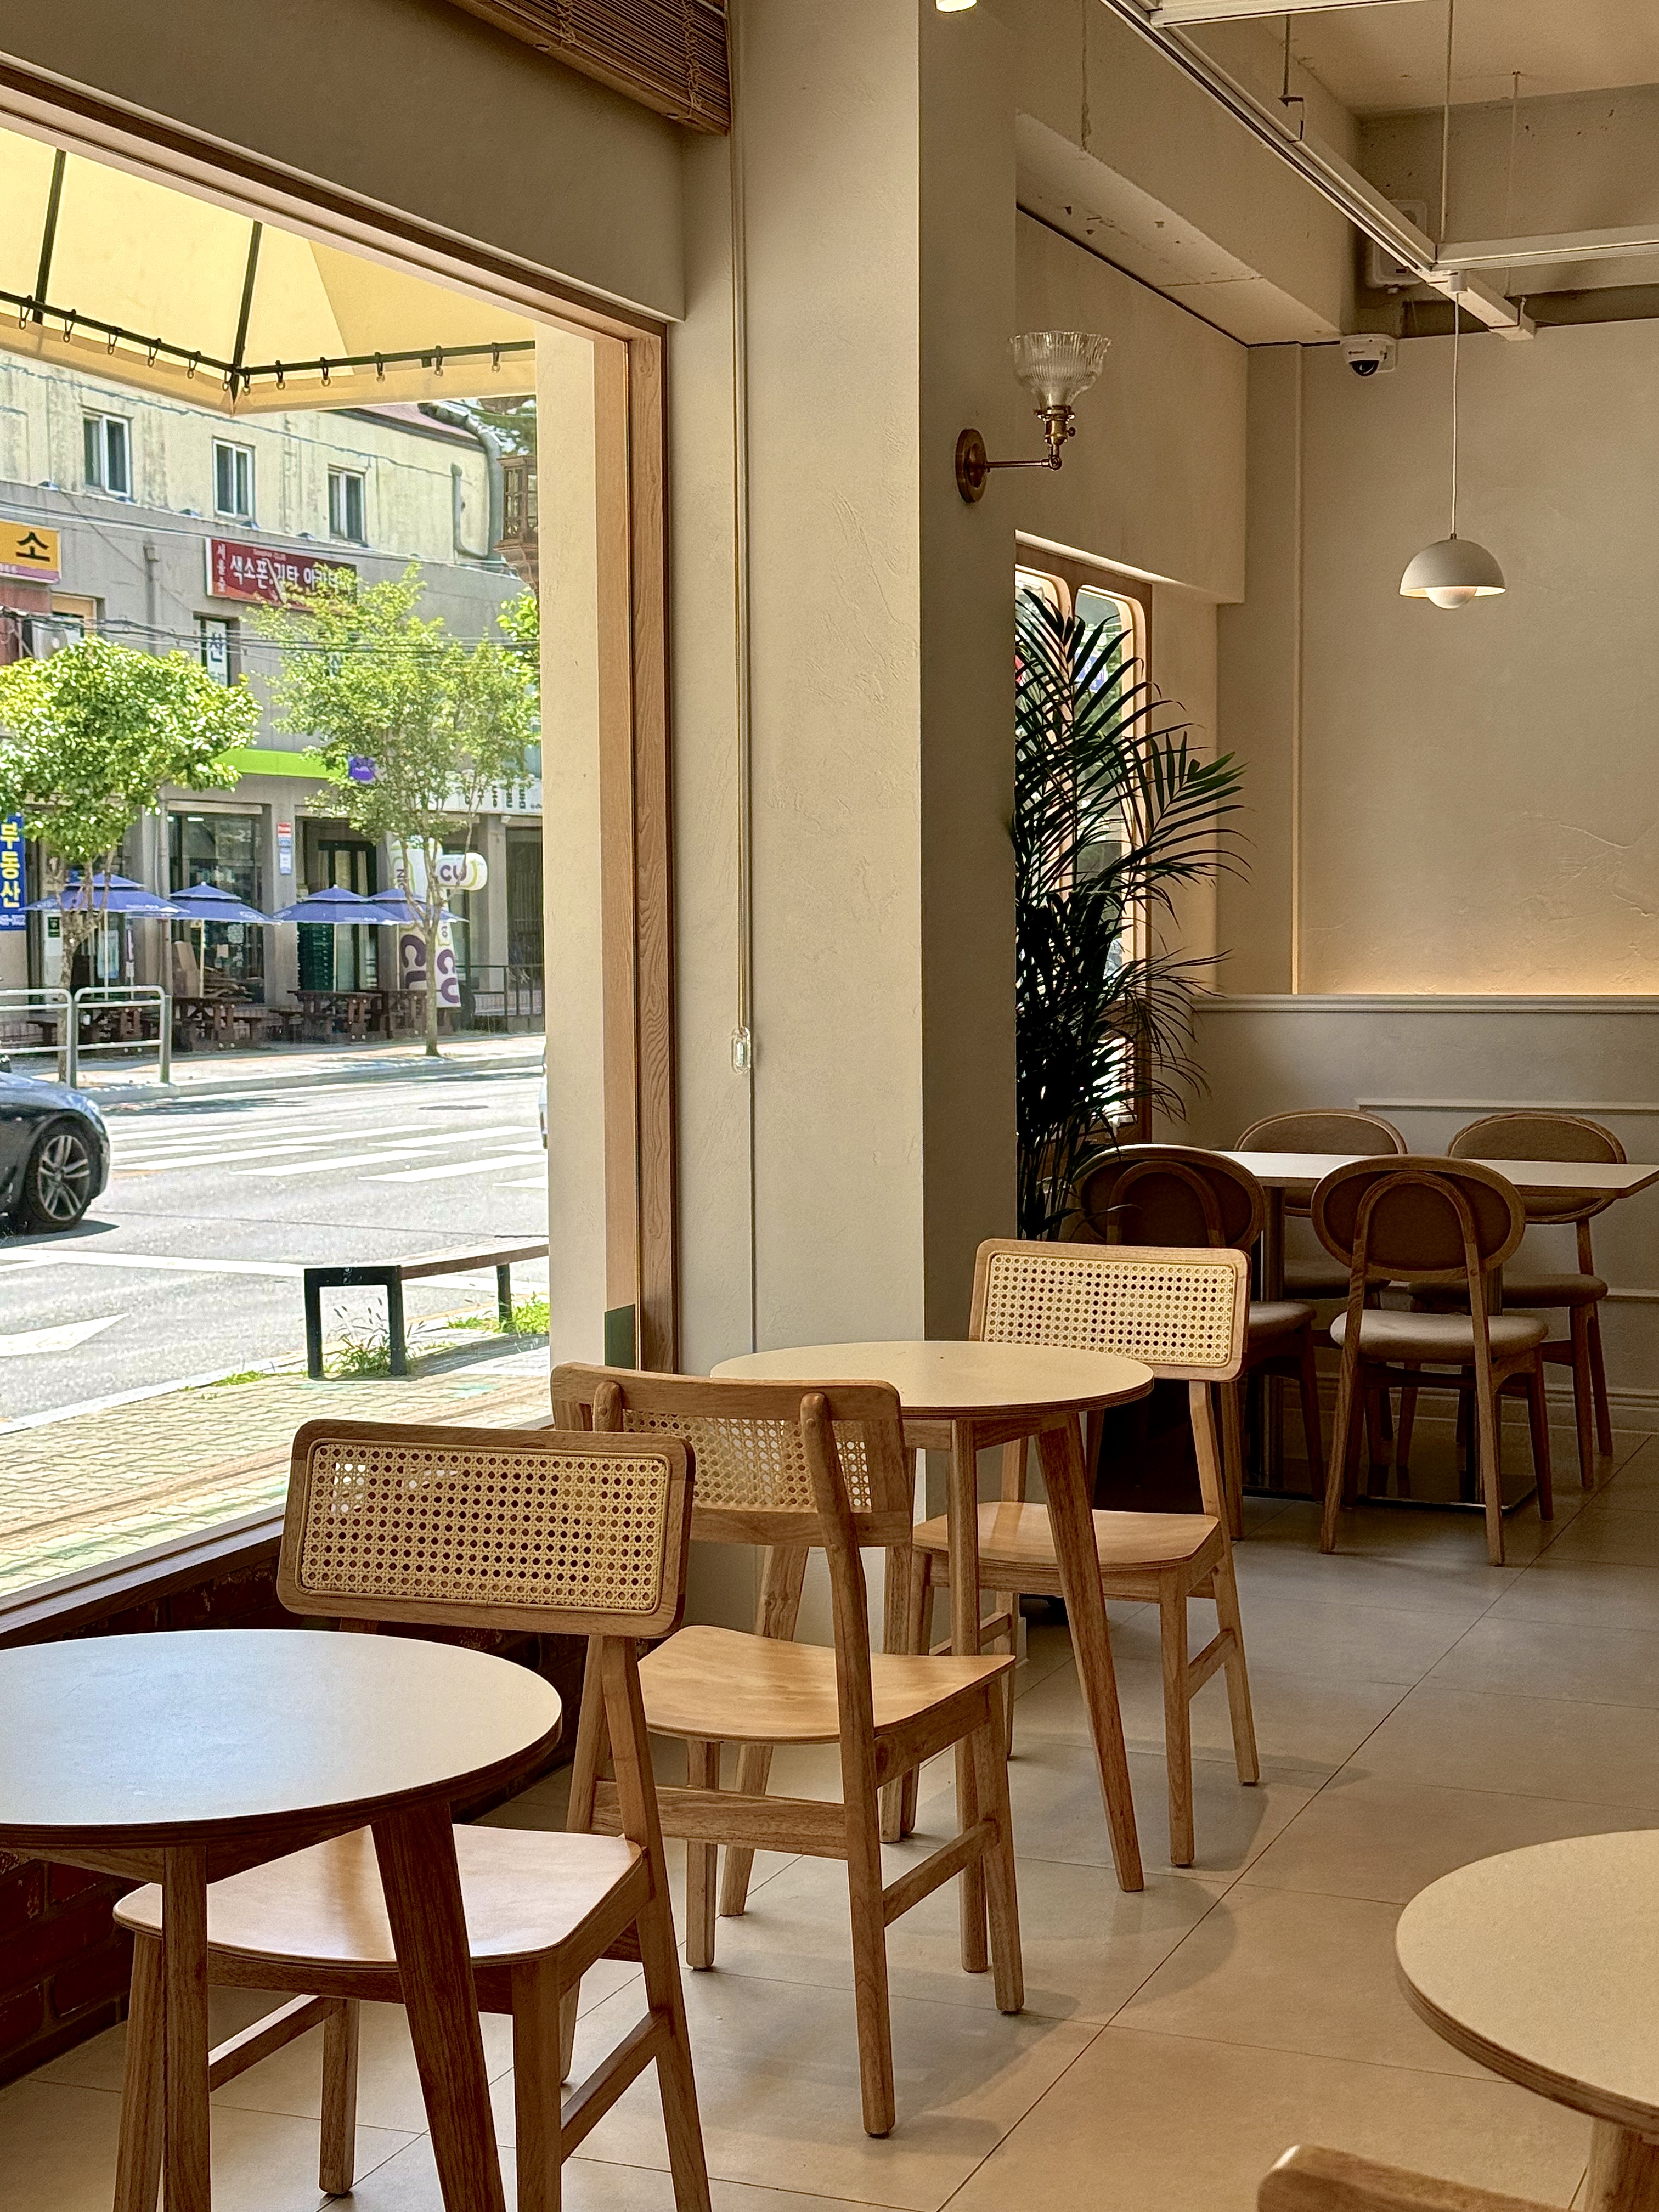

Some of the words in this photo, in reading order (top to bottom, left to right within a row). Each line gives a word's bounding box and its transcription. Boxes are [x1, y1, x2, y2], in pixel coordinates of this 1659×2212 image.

[15, 531, 50, 562] 소
[0, 822, 20, 909] 부동산
[439, 865, 467, 882] CU
[437, 949, 460, 1003] CU
